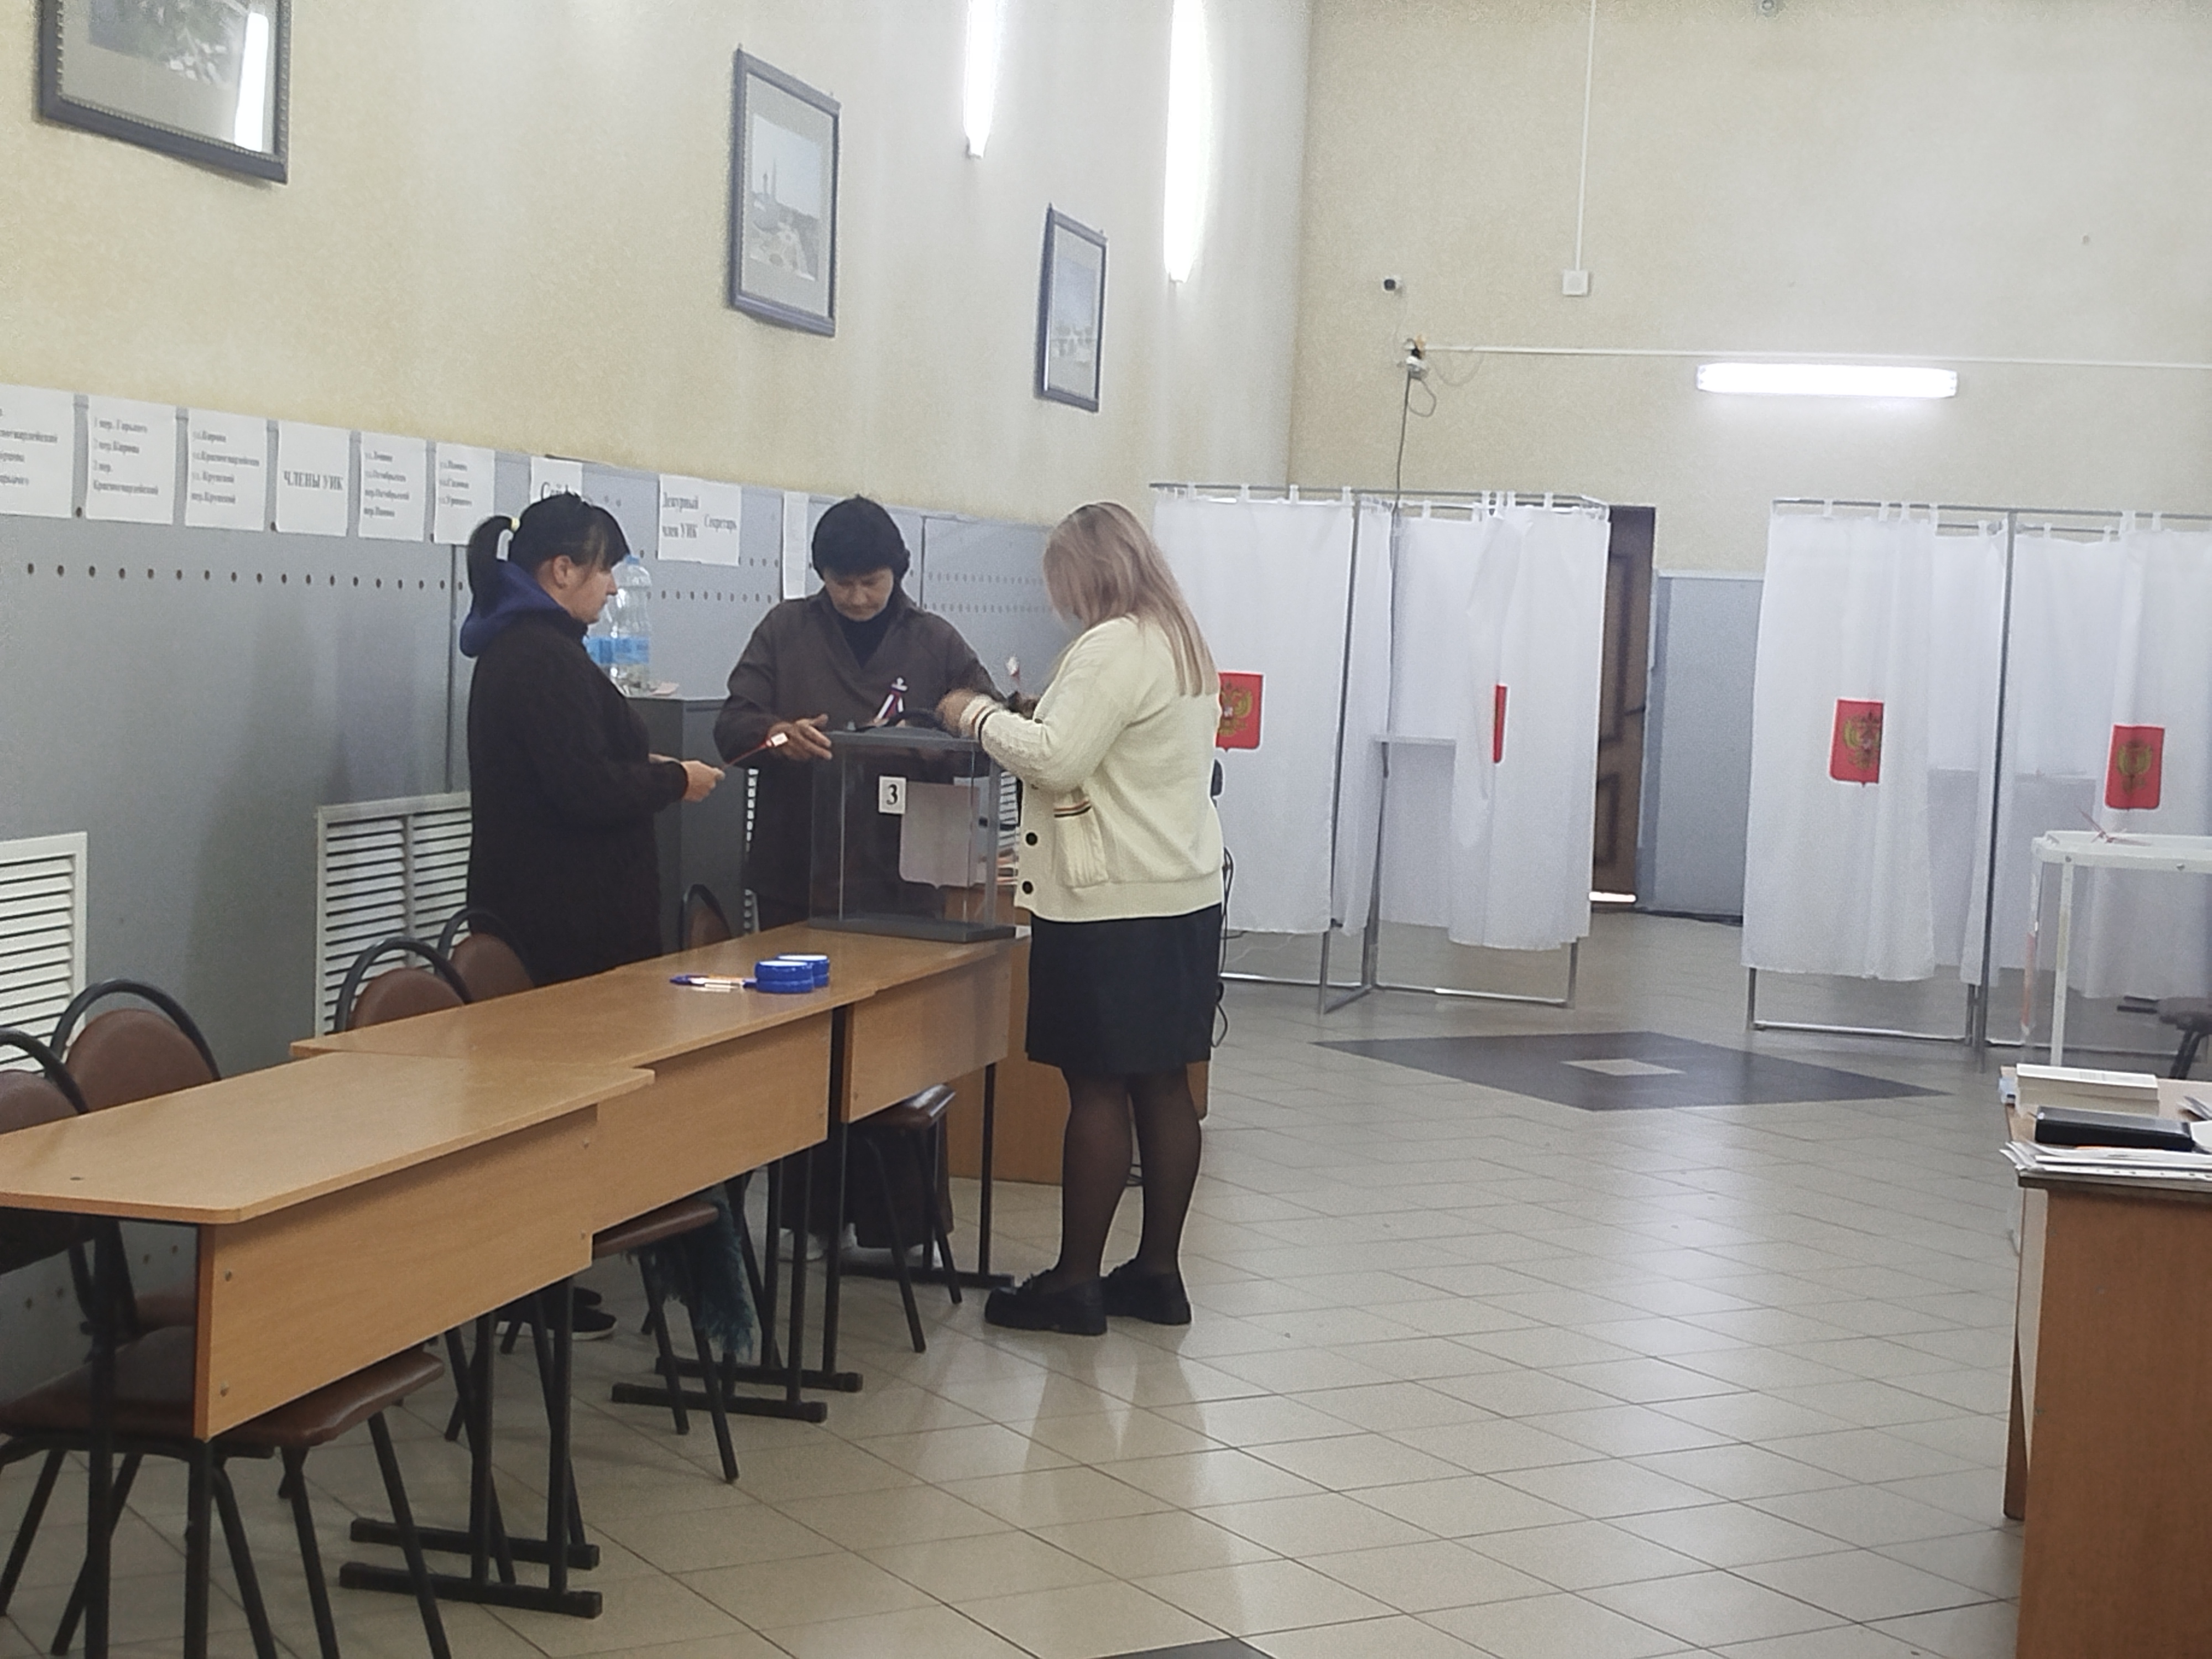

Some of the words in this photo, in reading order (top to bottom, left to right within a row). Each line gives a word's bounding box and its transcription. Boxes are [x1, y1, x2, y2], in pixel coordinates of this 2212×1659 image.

[283, 470, 321, 489] ЧЛЕНЫ
[322, 474, 343, 491] УИК
[680, 523, 698, 538] УИК
[886, 784, 898, 805] 3
